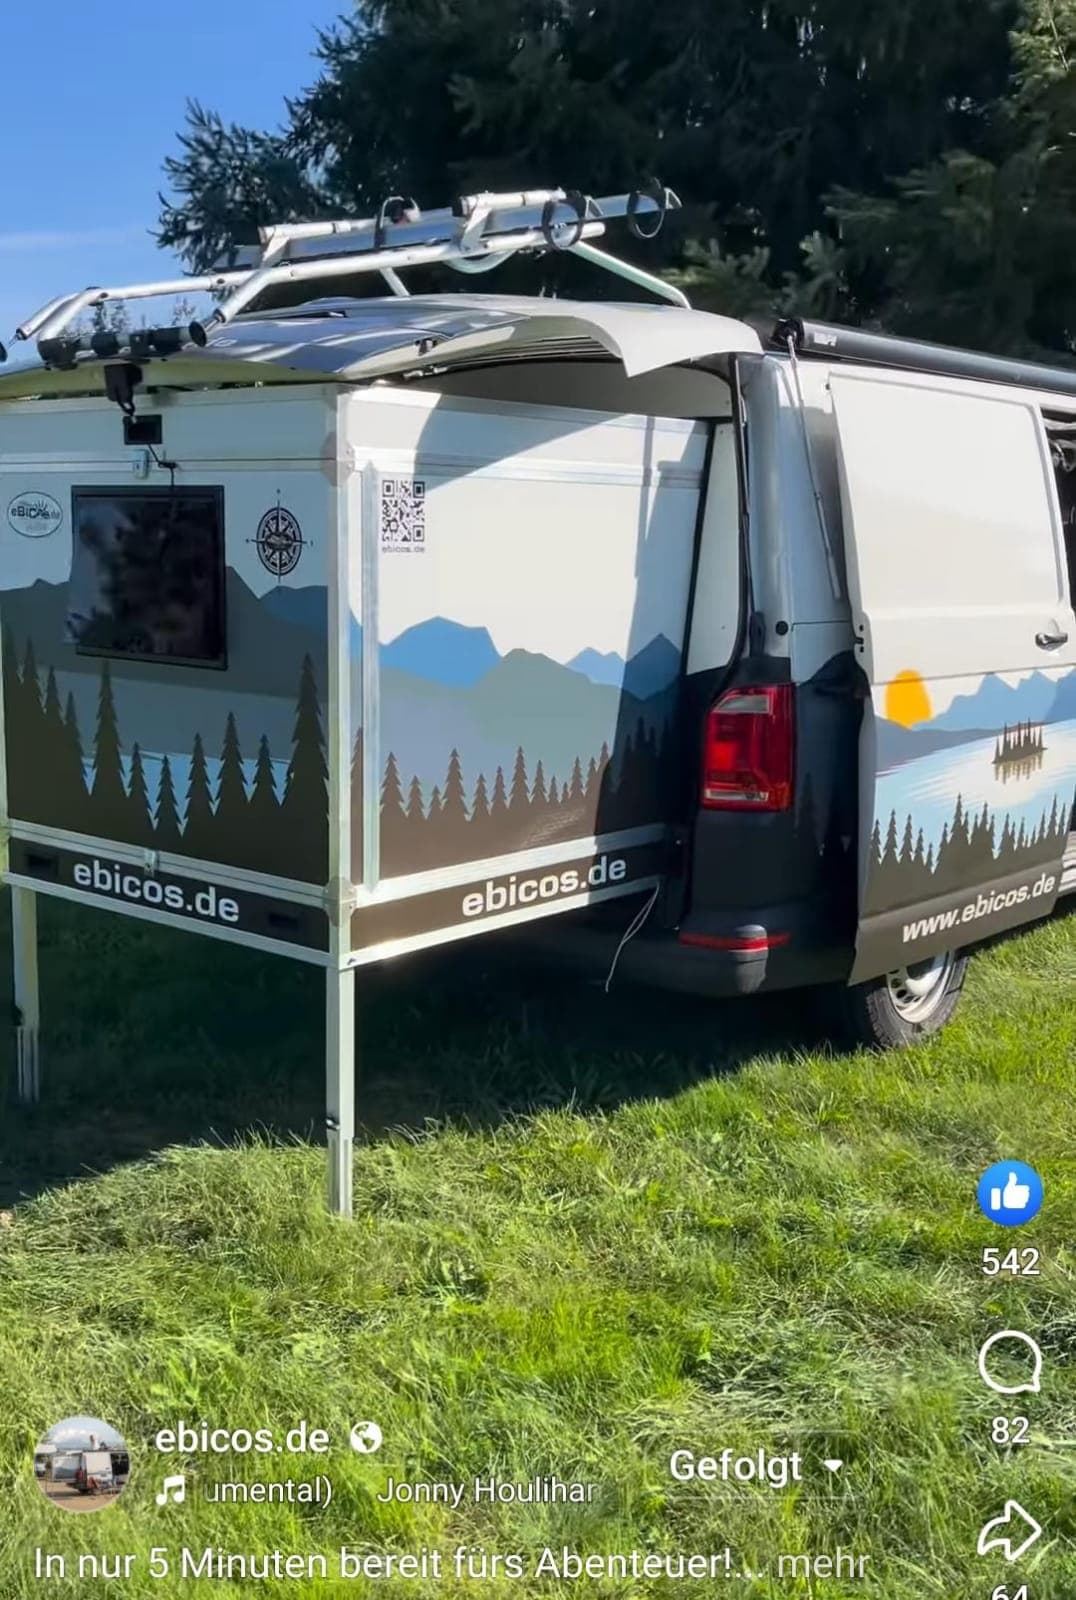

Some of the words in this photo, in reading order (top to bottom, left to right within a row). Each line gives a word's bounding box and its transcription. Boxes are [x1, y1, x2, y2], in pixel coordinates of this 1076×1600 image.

[73, 860, 239, 922] ebicos.de
[462, 856, 626, 916] ebicos.de
[902, 872, 1056, 943] www.ebicos.de
